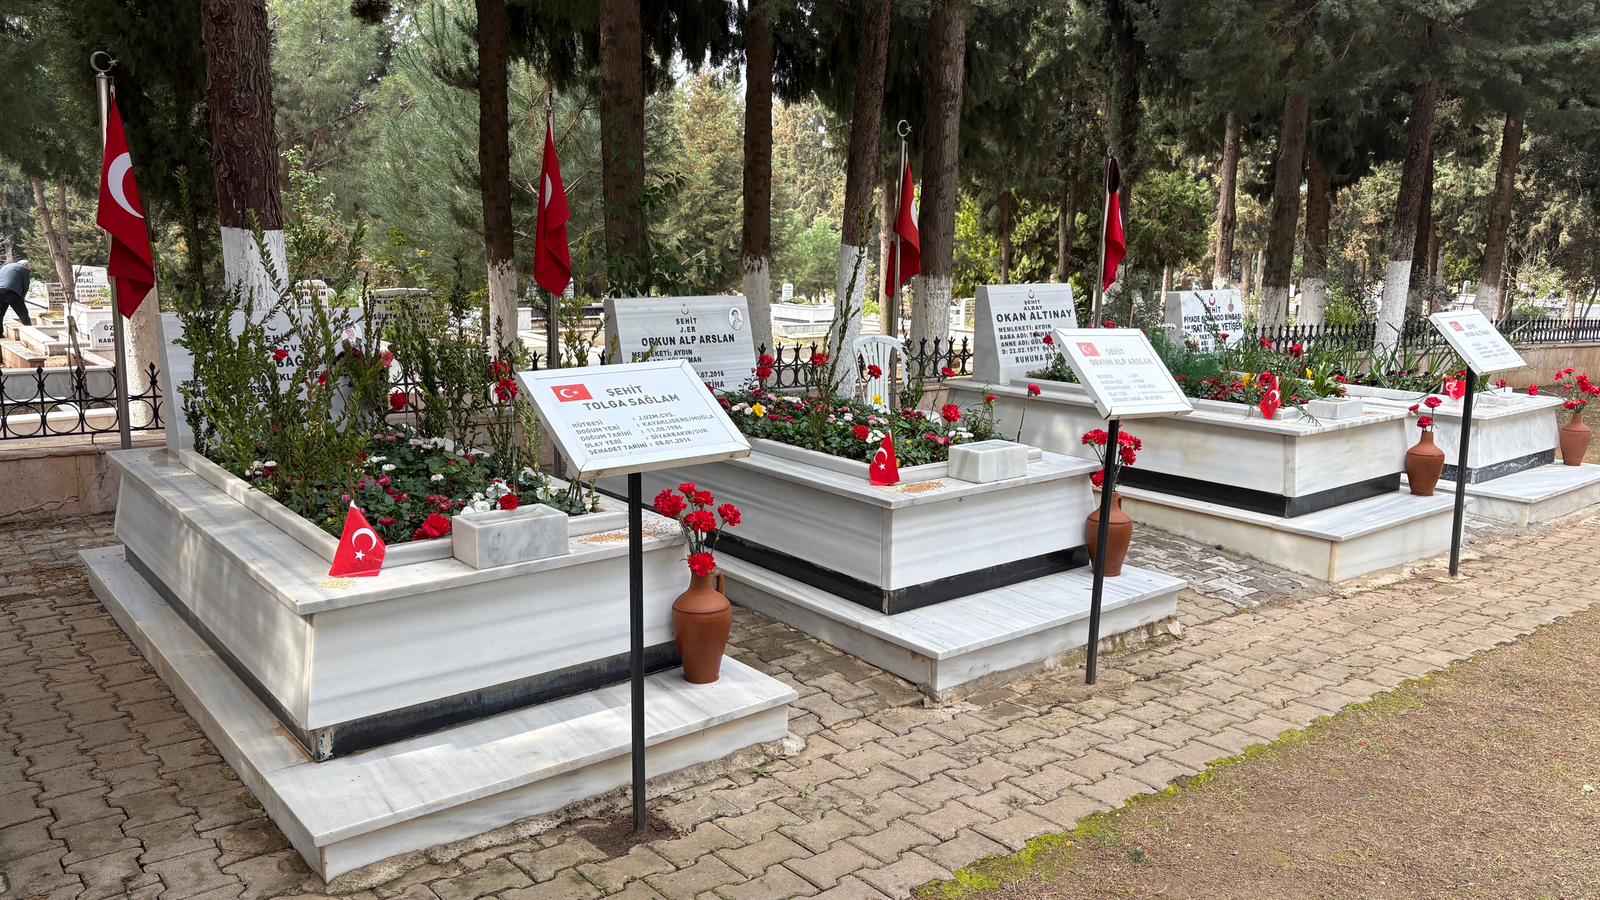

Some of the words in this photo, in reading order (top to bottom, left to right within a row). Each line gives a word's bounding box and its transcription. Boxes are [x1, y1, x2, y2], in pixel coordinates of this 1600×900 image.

[676, 316, 697, 325] ŞEHİT
[996, 312, 1027, 323] OKAN
[1030, 309, 1072, 321] ALTINAY
[641, 336, 676, 347] ORKUN
[679, 335, 697, 345] ALP
[699, 333, 735, 344] ARSLAN
[1015, 354, 1043, 363] RUHUNA
[606, 384, 643, 397] ŞEHİT
[582, 400, 627, 411] TOLGA
[628, 394, 681, 406] SAĞLAM
[572, 419, 604, 428] RÜTBESİ
[576, 427, 602, 435] DOĞUM
[607, 430, 632, 438] TARİHİ
[588, 446, 622, 455] ŞEHADET
[622, 442, 648, 450] TARİHİ
